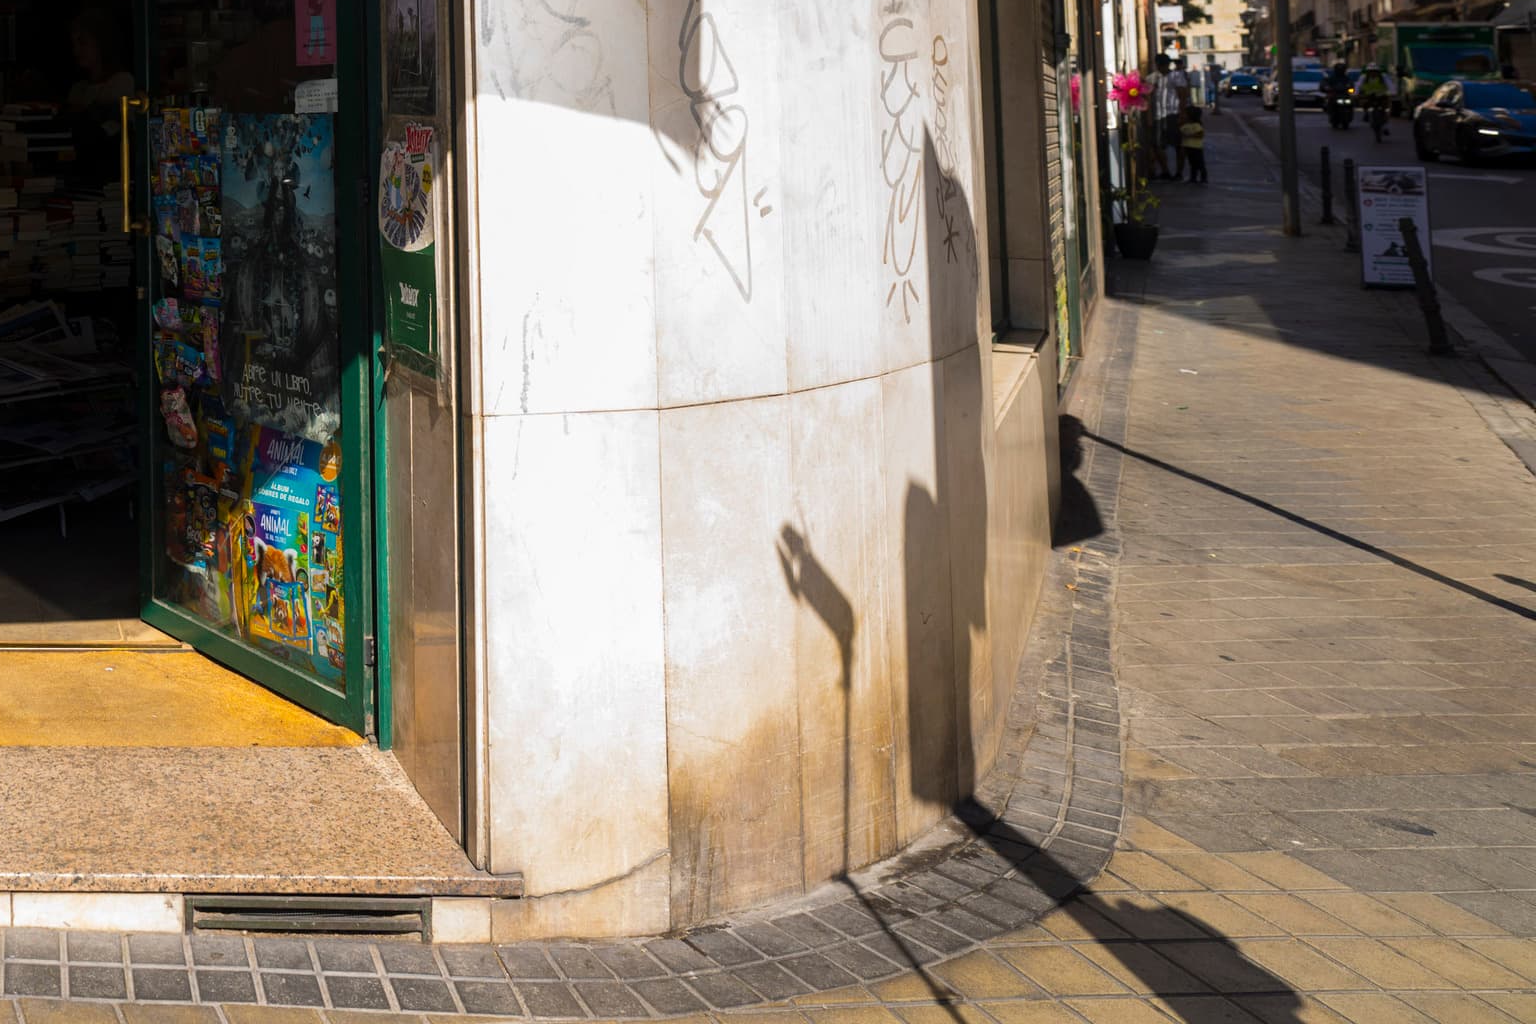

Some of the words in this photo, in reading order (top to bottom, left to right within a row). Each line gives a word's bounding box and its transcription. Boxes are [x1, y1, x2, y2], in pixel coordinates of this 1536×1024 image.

[267, 438, 305, 467] ANIMAL
[279, 493, 287, 501] DE
[287, 494, 310, 506] REGALO
[260, 513, 292, 538] ANIMAL
